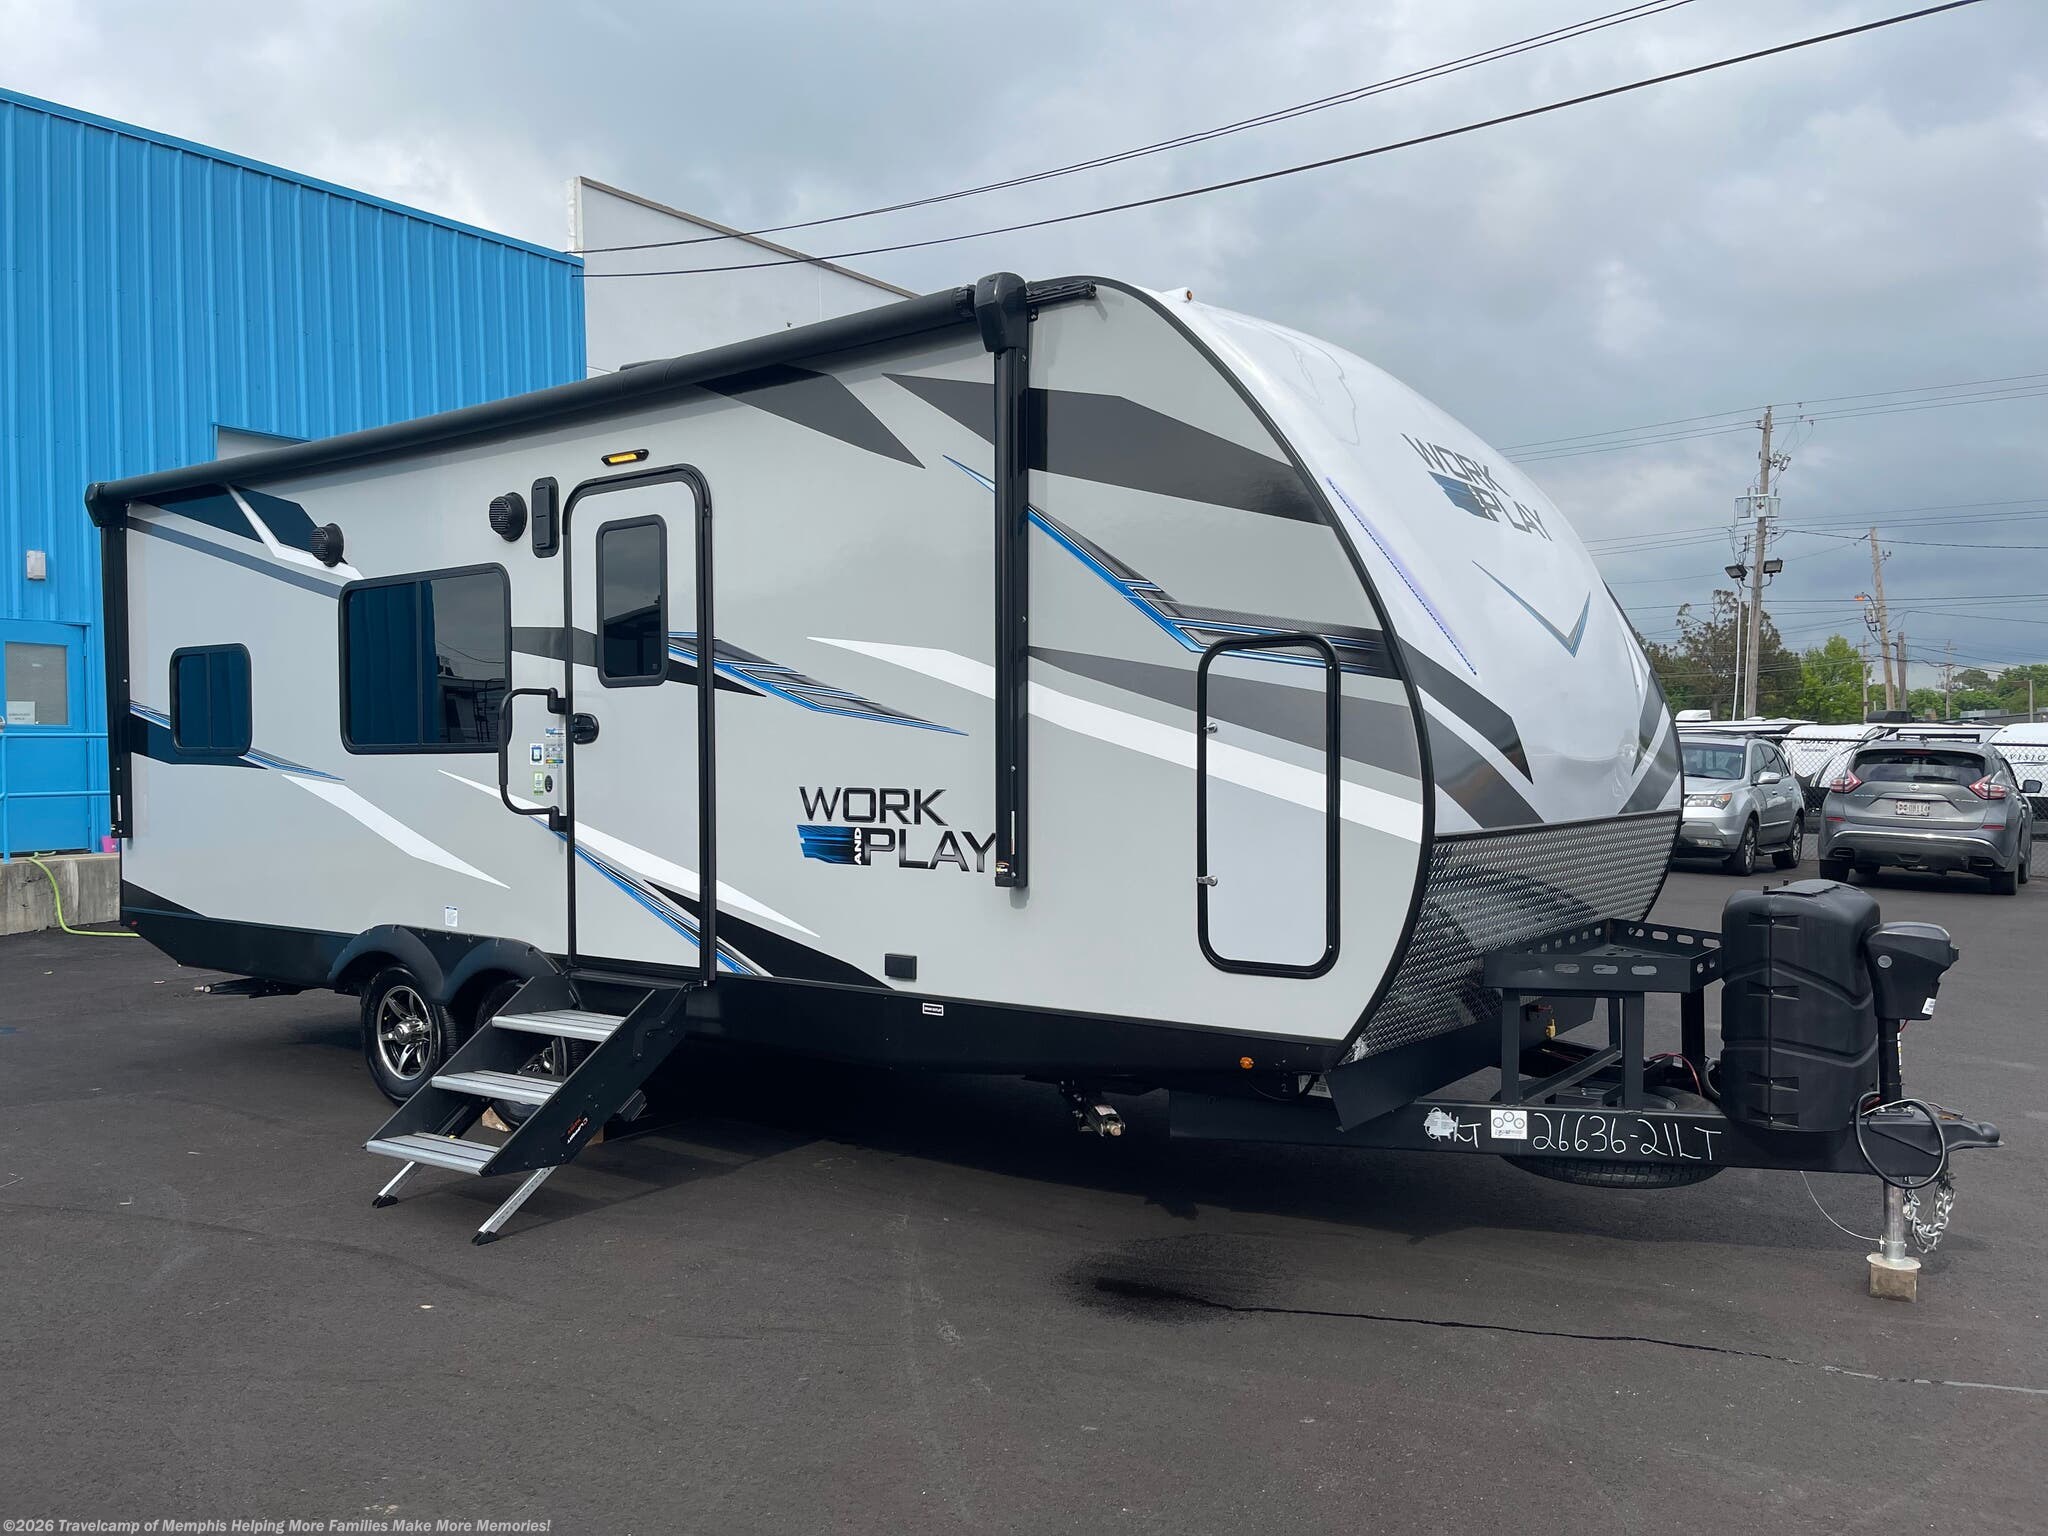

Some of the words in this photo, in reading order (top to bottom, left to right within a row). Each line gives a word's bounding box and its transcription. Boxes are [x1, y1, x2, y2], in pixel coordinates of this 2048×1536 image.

[1400, 433, 1511, 497] WORK
[1469, 484, 1552, 541] PLAY
[799, 786, 949, 826] WORK
[853, 827, 862, 865] AND
[862, 828, 996, 873] PLAY
[1533, 1113, 1722, 1160] 26636-21LT
